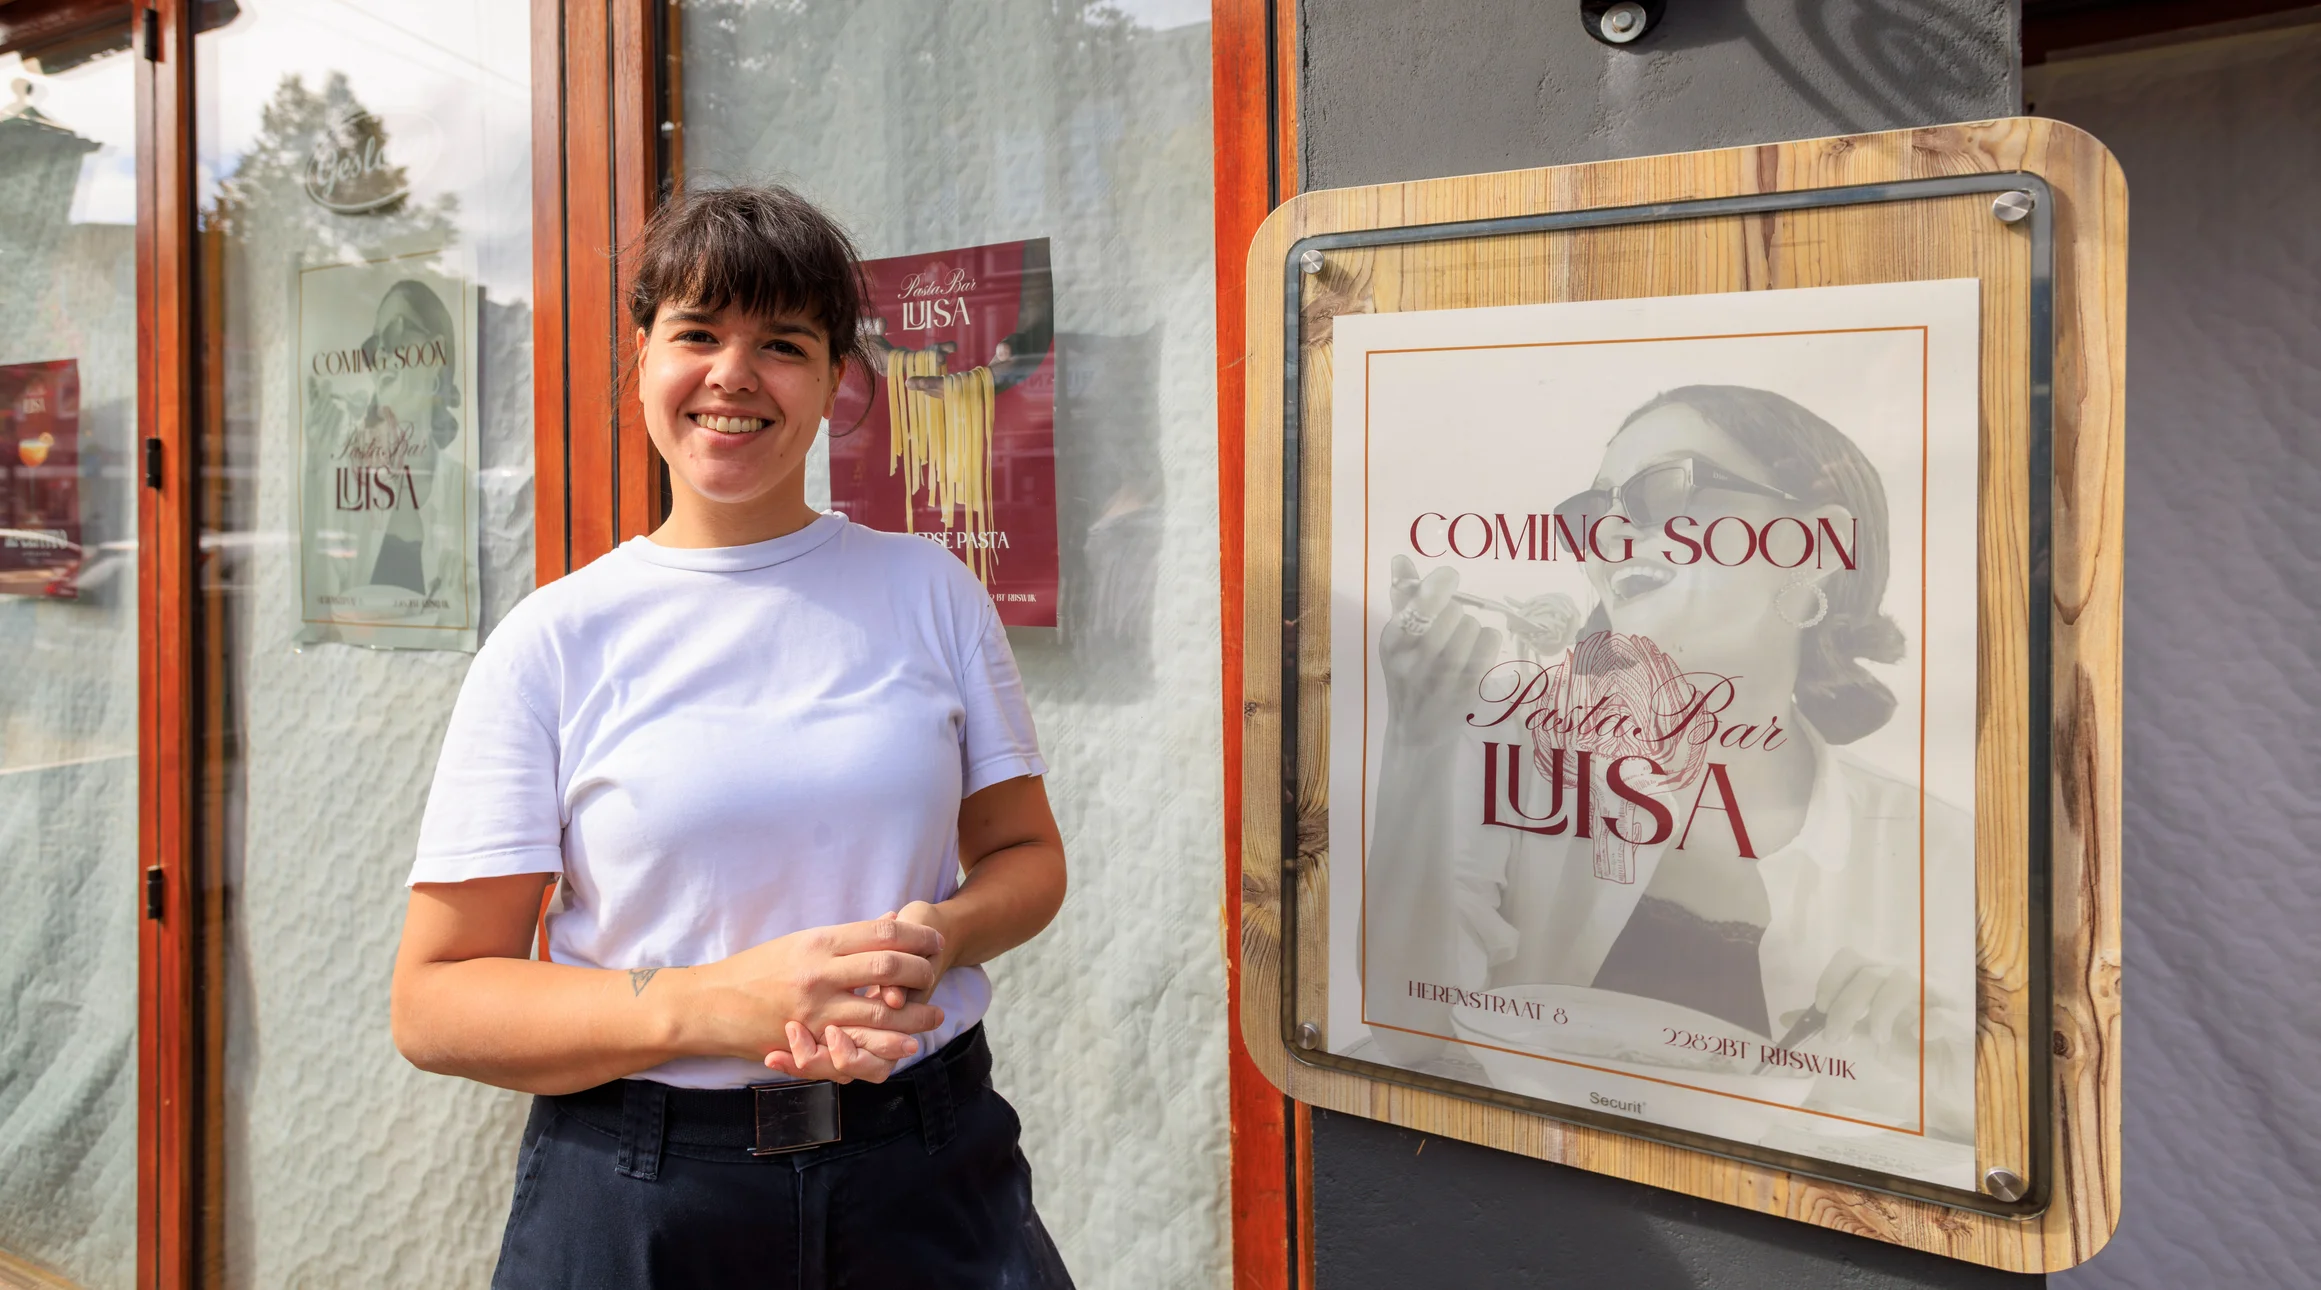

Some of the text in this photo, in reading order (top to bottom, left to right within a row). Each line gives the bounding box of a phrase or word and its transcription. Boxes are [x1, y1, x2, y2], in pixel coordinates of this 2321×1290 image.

[897, 267, 977, 300] Pasta Bar
[902, 296, 971, 331] LUISA
[312, 340, 447, 377] COMING SOON
[336, 464, 420, 512] LUISA
[956, 531, 1011, 549] PASTA
[1409, 512, 1858, 571] COMING SOON
[1466, 659, 1789, 752] Pasta Bar
[1481, 741, 1759, 860] LUISA
[1408, 980, 1569, 1026] HERENSTRAAT 8
[1662, 1026, 1857, 1082] 2282BT RIJSWIJK
